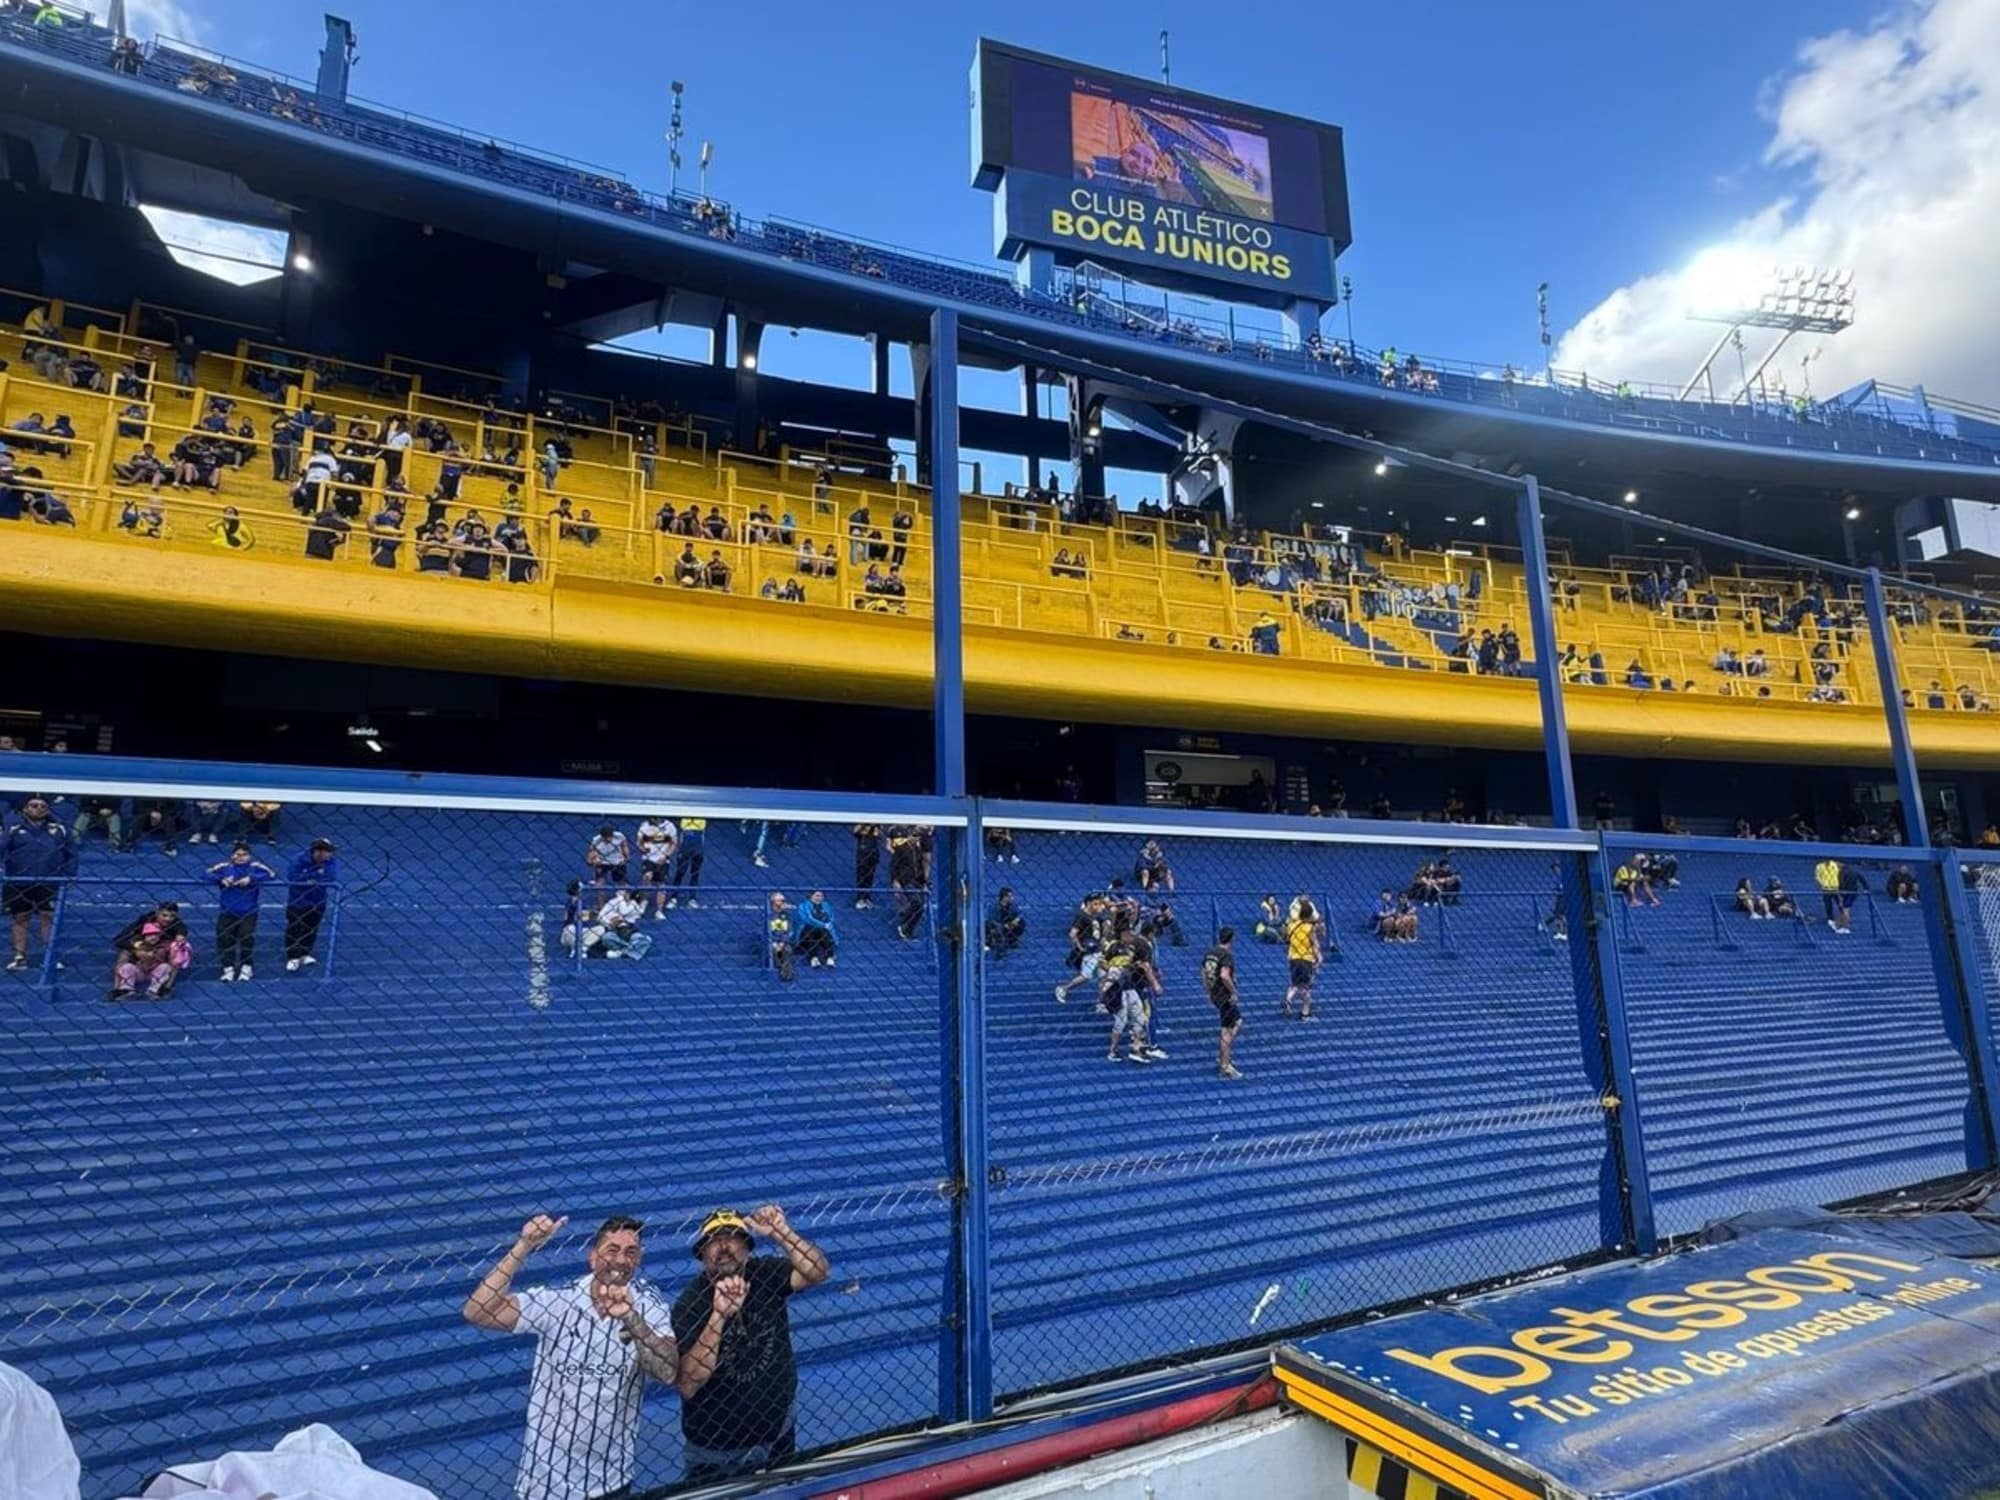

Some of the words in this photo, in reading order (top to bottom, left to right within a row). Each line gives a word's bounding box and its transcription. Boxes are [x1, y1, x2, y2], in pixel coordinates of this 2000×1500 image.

[1052, 209, 1146, 250] BOCA
[1154, 231, 1292, 280] JUNIORS
[1071, 188, 1146, 222] CLUB
[1153, 206, 1272, 249] ATLÉTICO
[1383, 1252, 1923, 1394] betsson
[1509, 1394, 1600, 1424] Tu
[1588, 1366, 1695, 1405] sitio
[1680, 1351, 1748, 1376] de
[1735, 1301, 1895, 1357] apuestas
